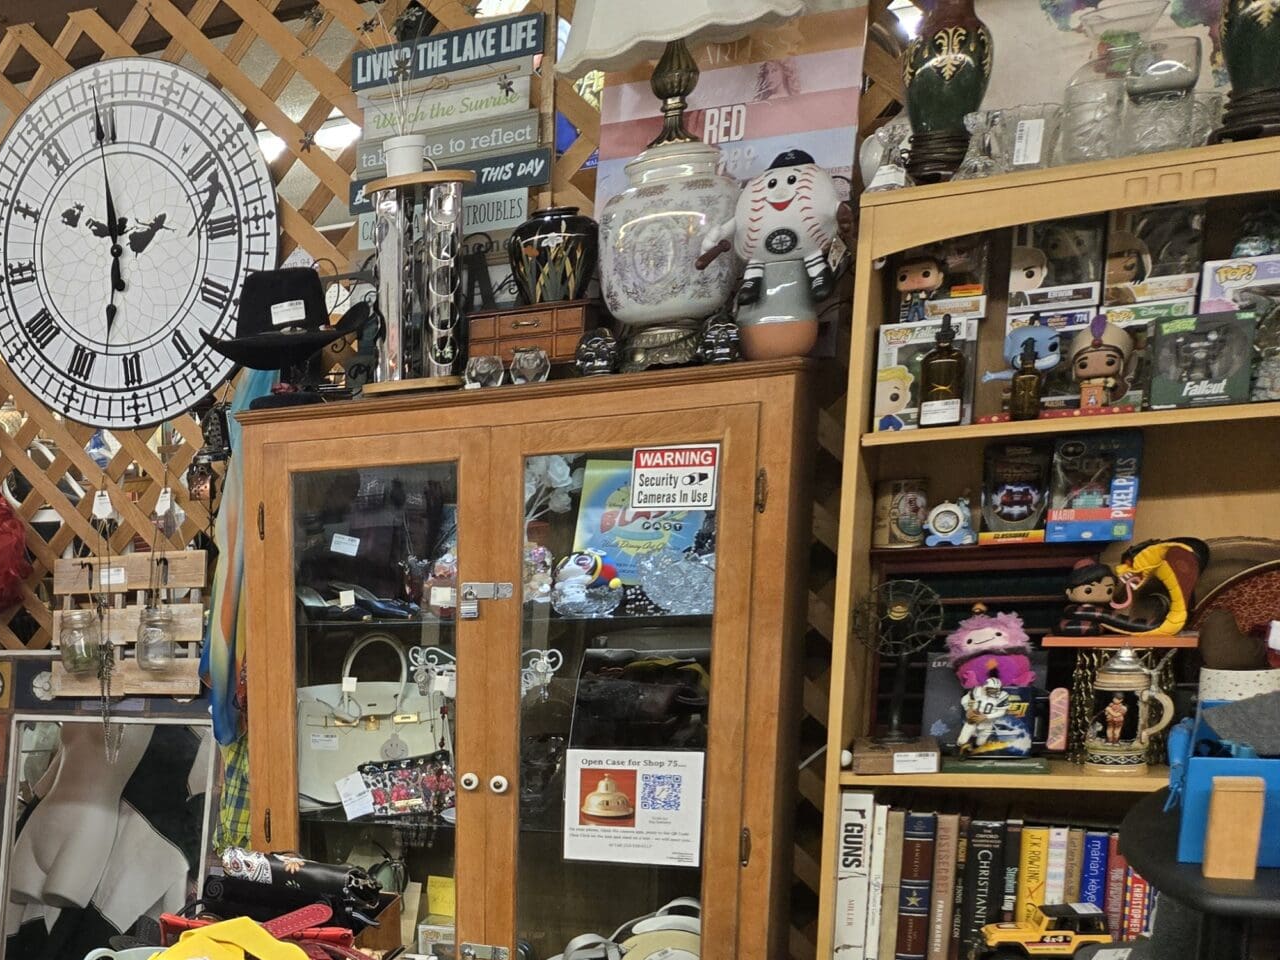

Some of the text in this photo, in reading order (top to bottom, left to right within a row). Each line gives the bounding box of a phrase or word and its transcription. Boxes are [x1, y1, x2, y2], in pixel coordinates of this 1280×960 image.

[417, 39, 448, 71] THE
[452, 28, 497, 64] LAKE
[501, 19, 537, 54] LIFE
[429, 103, 456, 121] the
[458, 91, 519, 114] Sunrise
[703, 103, 746, 144] RED
[361, 148, 387, 168] tak
[449, 138, 465, 153] to
[470, 125, 531, 150] reflect
[481, 158, 545, 184] THIS DAY
[465, 197, 523, 226] TROUBLES
[1215, 264, 1257, 284] POP!
[1140, 307, 1169, 318] Disney
[1182, 378, 1228, 397] Fallout
[639, 451, 712, 466] WARNING
[639, 473, 679, 488] Security
[1111, 457, 1137, 518] PIXEL PALS
[637, 489, 708, 504] Cameras In Use
[642, 521, 683, 532] PAST
[1052, 510, 1076, 521] MARIO
[977, 700, 994, 715] 10
[581, 758, 603, 767] Open
[606, 758, 625, 767] Case
[627, 758, 640, 767] for
[643, 759, 664, 768] Shop
[842, 822, 864, 868] GUNS
[1026, 851, 1041, 883] ROWLING
[1084, 840, 1104, 904] marian keye
[973, 850, 993, 932] CHRISTIANIT
[1001, 867, 1018, 910] Stephen King
[846, 899, 856, 927] MILLER
[935, 900, 945, 922] FRANK
[1129, 883, 1144, 933] CHRISTOPHER
[933, 924, 943, 953] WARREN
[1043, 935, 1064, 944] 4x4
